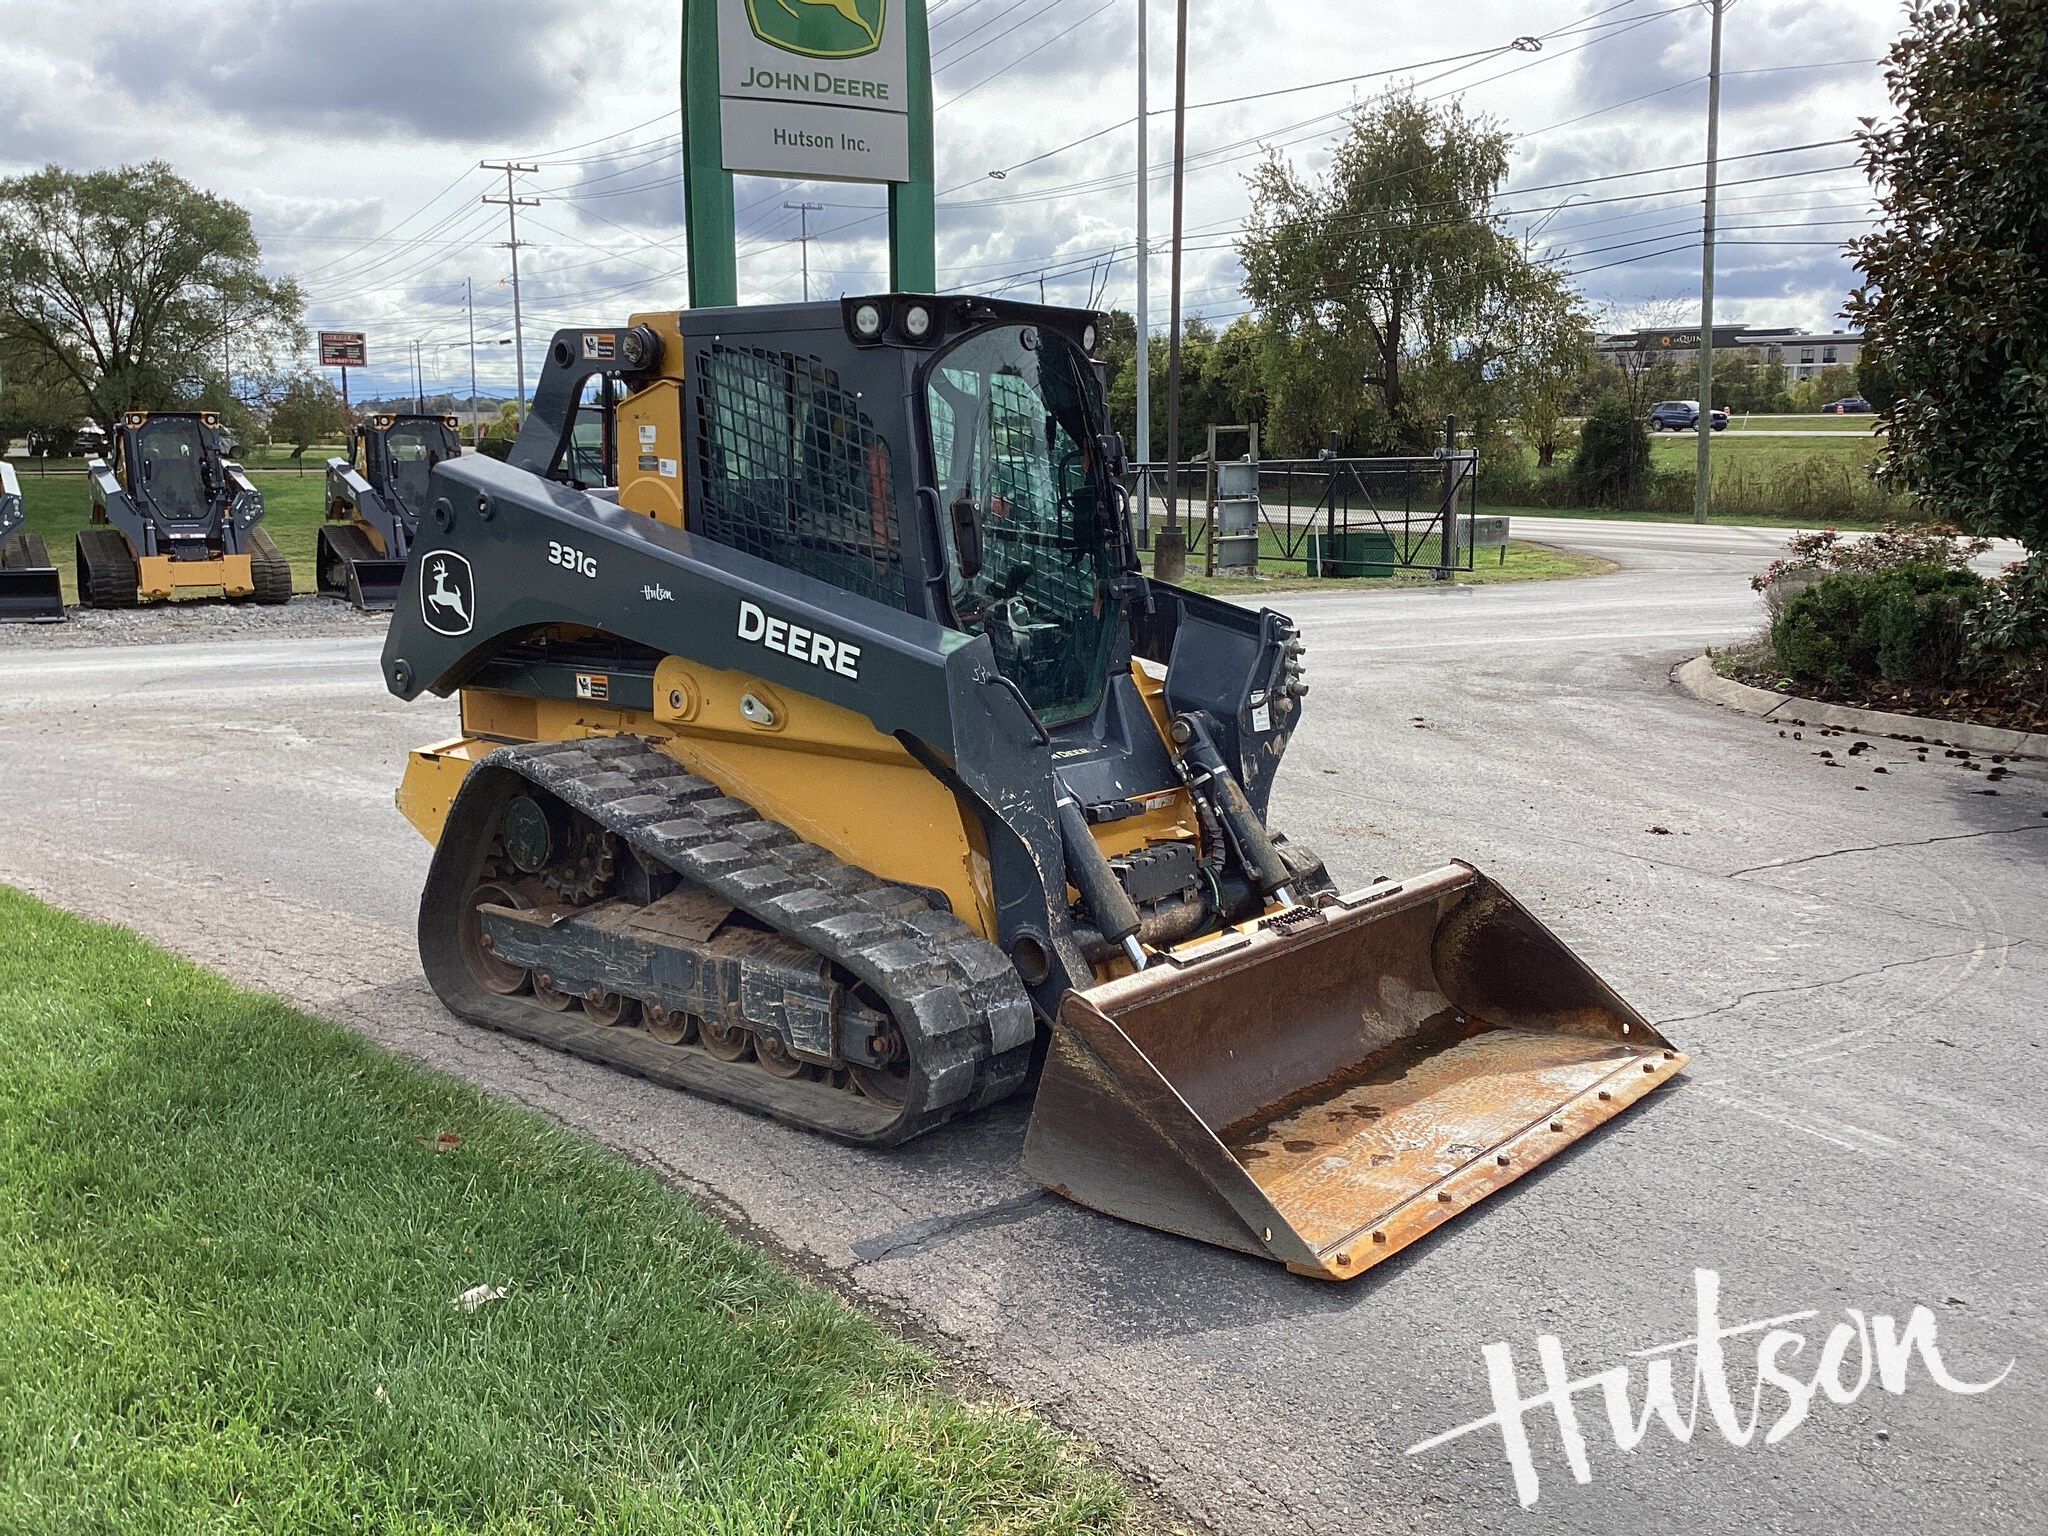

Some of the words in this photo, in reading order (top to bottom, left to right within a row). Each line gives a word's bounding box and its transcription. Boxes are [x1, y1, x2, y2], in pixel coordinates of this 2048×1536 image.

[741, 67, 809, 91] JOHN
[814, 72, 889, 100] DEERE
[774, 128, 834, 149] Hutson
[841, 134, 871, 152] Inc.
[548, 541, 597, 578] 331G
[640, 583, 675, 601] Hutson
[738, 600, 860, 679] DEERE
